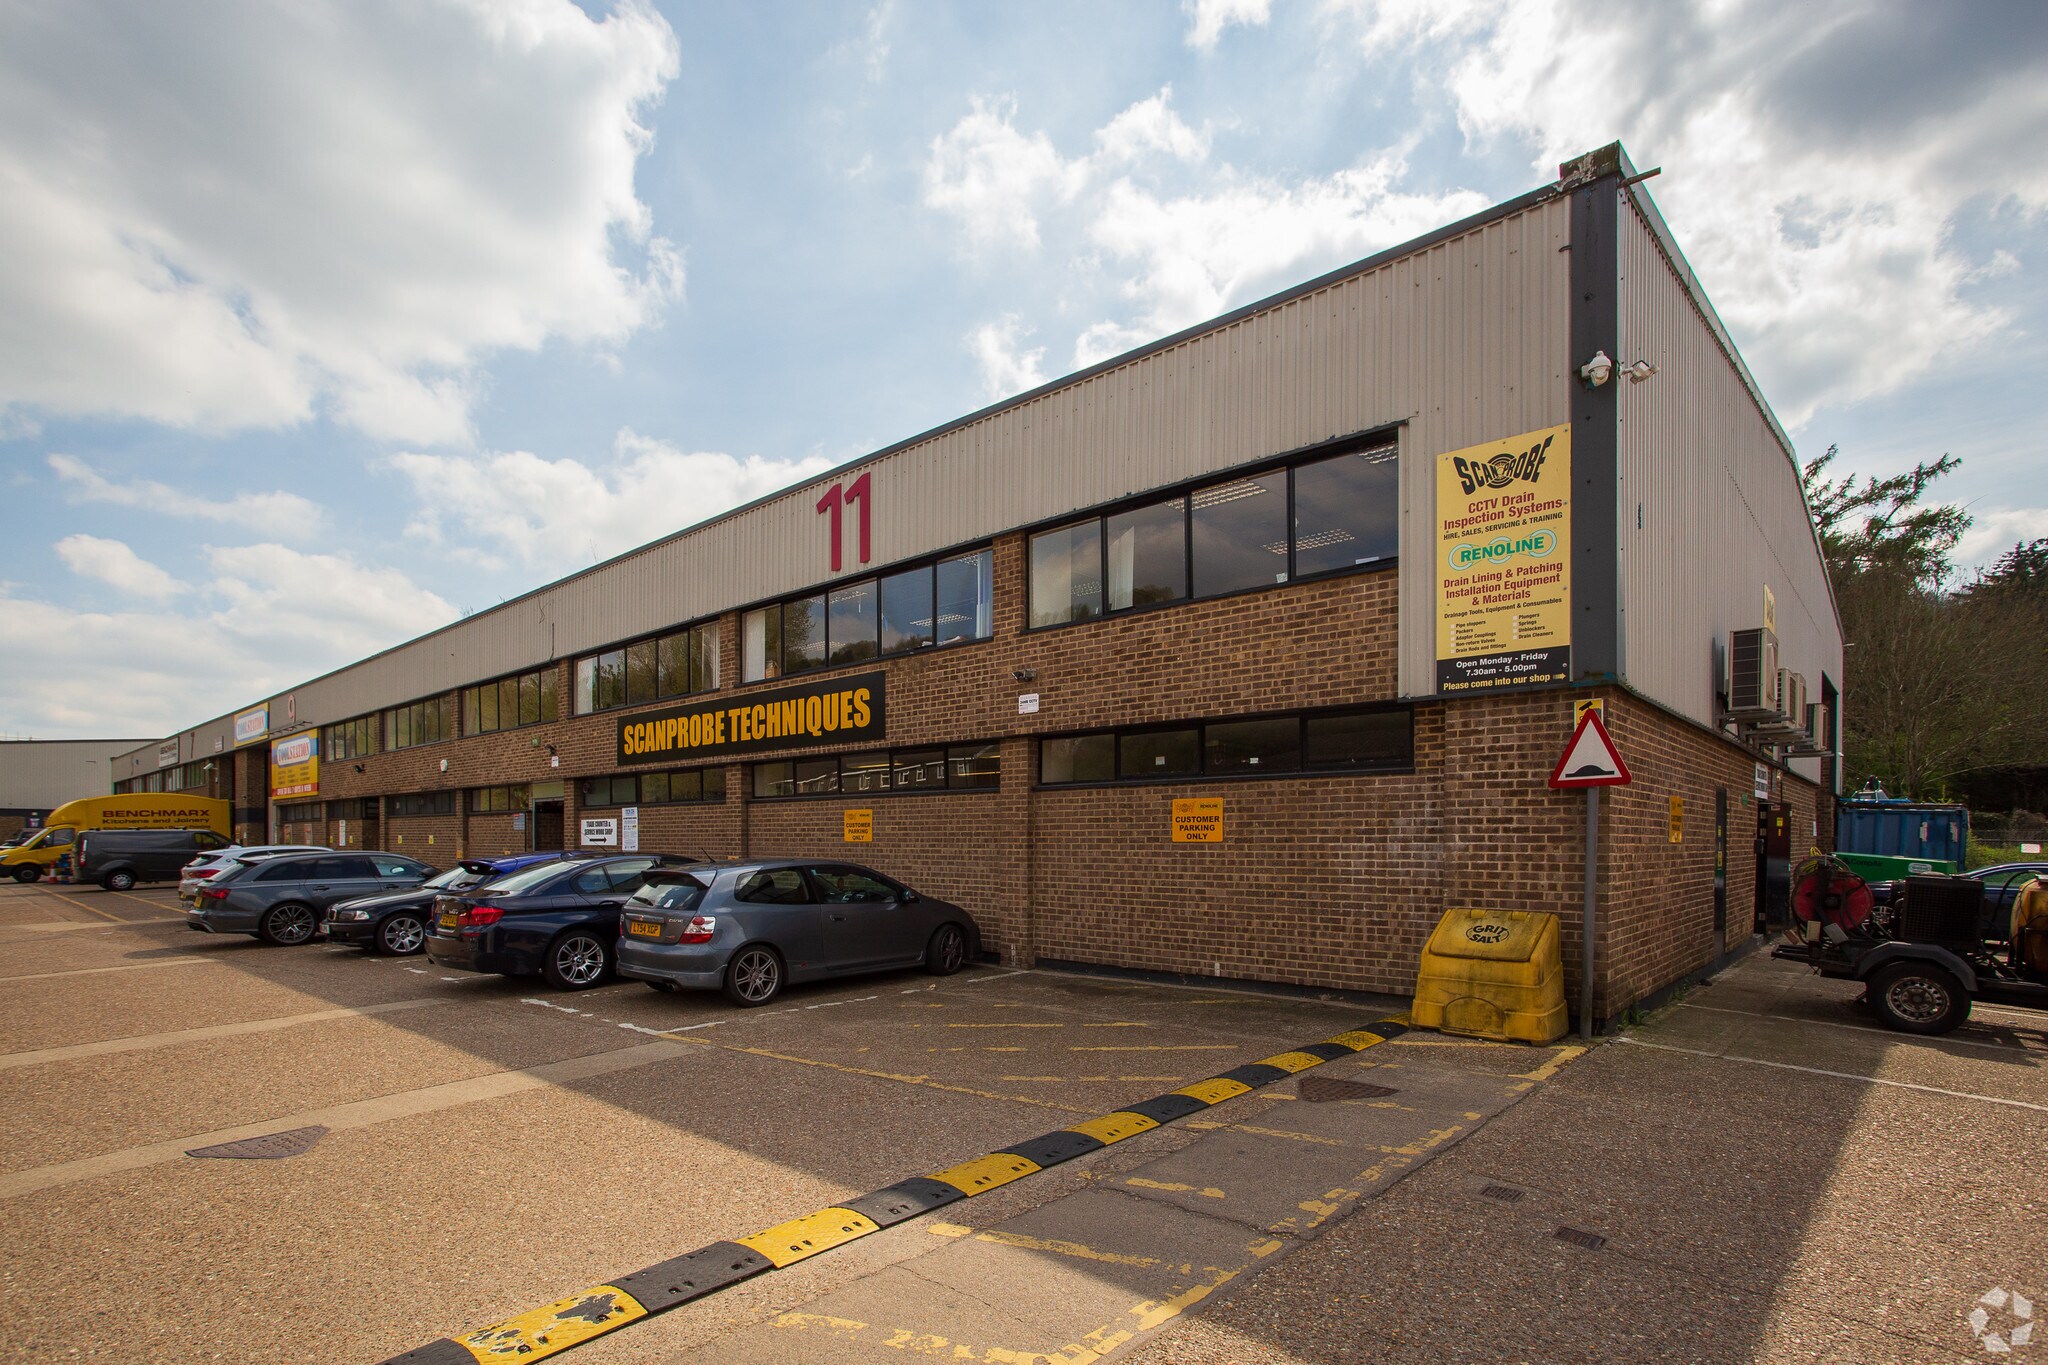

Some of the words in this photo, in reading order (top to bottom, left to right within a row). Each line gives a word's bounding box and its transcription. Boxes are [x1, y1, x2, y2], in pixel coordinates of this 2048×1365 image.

[1468, 498, 1498, 514] CCTV
[1502, 492, 1535, 507] Drain
[816, 472, 871, 572] 11
[1444, 510, 1504, 531] Inspection
[1508, 499, 1562, 519] Systems
[1443, 532, 1460, 541] HIRE,
[1461, 528, 1484, 538] SALES,
[1485, 520, 1520, 533] SERVICING
[1529, 512, 1563, 525] TRAINING
[1460, 537, 1545, 562] RENOLINE
[1443, 576, 1469, 588] Drain
[1472, 572, 1502, 584] Lining
[1505, 569, 1513, 578] &
[1516, 562, 1563, 577] Patching
[1446, 582, 1501, 599] Installation
[1504, 573, 1560, 591] Equipment
[1471, 596, 1480, 606] &
[1482, 590, 1531, 605] Materials
[1444, 611, 1468, 619] Drainage
[1469, 608, 1485, 616] Tools,
[1485, 603, 1516, 613] Equipment
[1522, 598, 1563, 608] Consumables
[1518, 612, 1540, 620] Plungers
[1518, 619, 1537, 627] Springs
[1456, 660, 1478, 670] Open
[1479, 656, 1513, 666] Monday
[1520, 652, 1549, 662] Friday
[1465, 668, 1497, 677] 7.30am
[1504, 664, 1538, 673] 5.00pm
[1443, 681, 1469, 691] Please
[1470, 680, 1493, 688] come
[1494, 677, 1511, 686] into
[1512, 676, 1527, 684] our
[1529, 673, 1551, 683] shop
[624, 710, 725, 755] SCANPROBE
[728, 687, 871, 743] TECHNIQUES
[102, 810, 210, 818] BENCHMARX
[174, 817, 210, 825] Joinery
[1179, 824, 1215, 832] PARKING
[633, 923, 646, 934] LT54
[647, 924, 659, 935] XGP
[1473, 925, 1507, 934] GRIT
[1469, 934, 1500, 943] SALT
